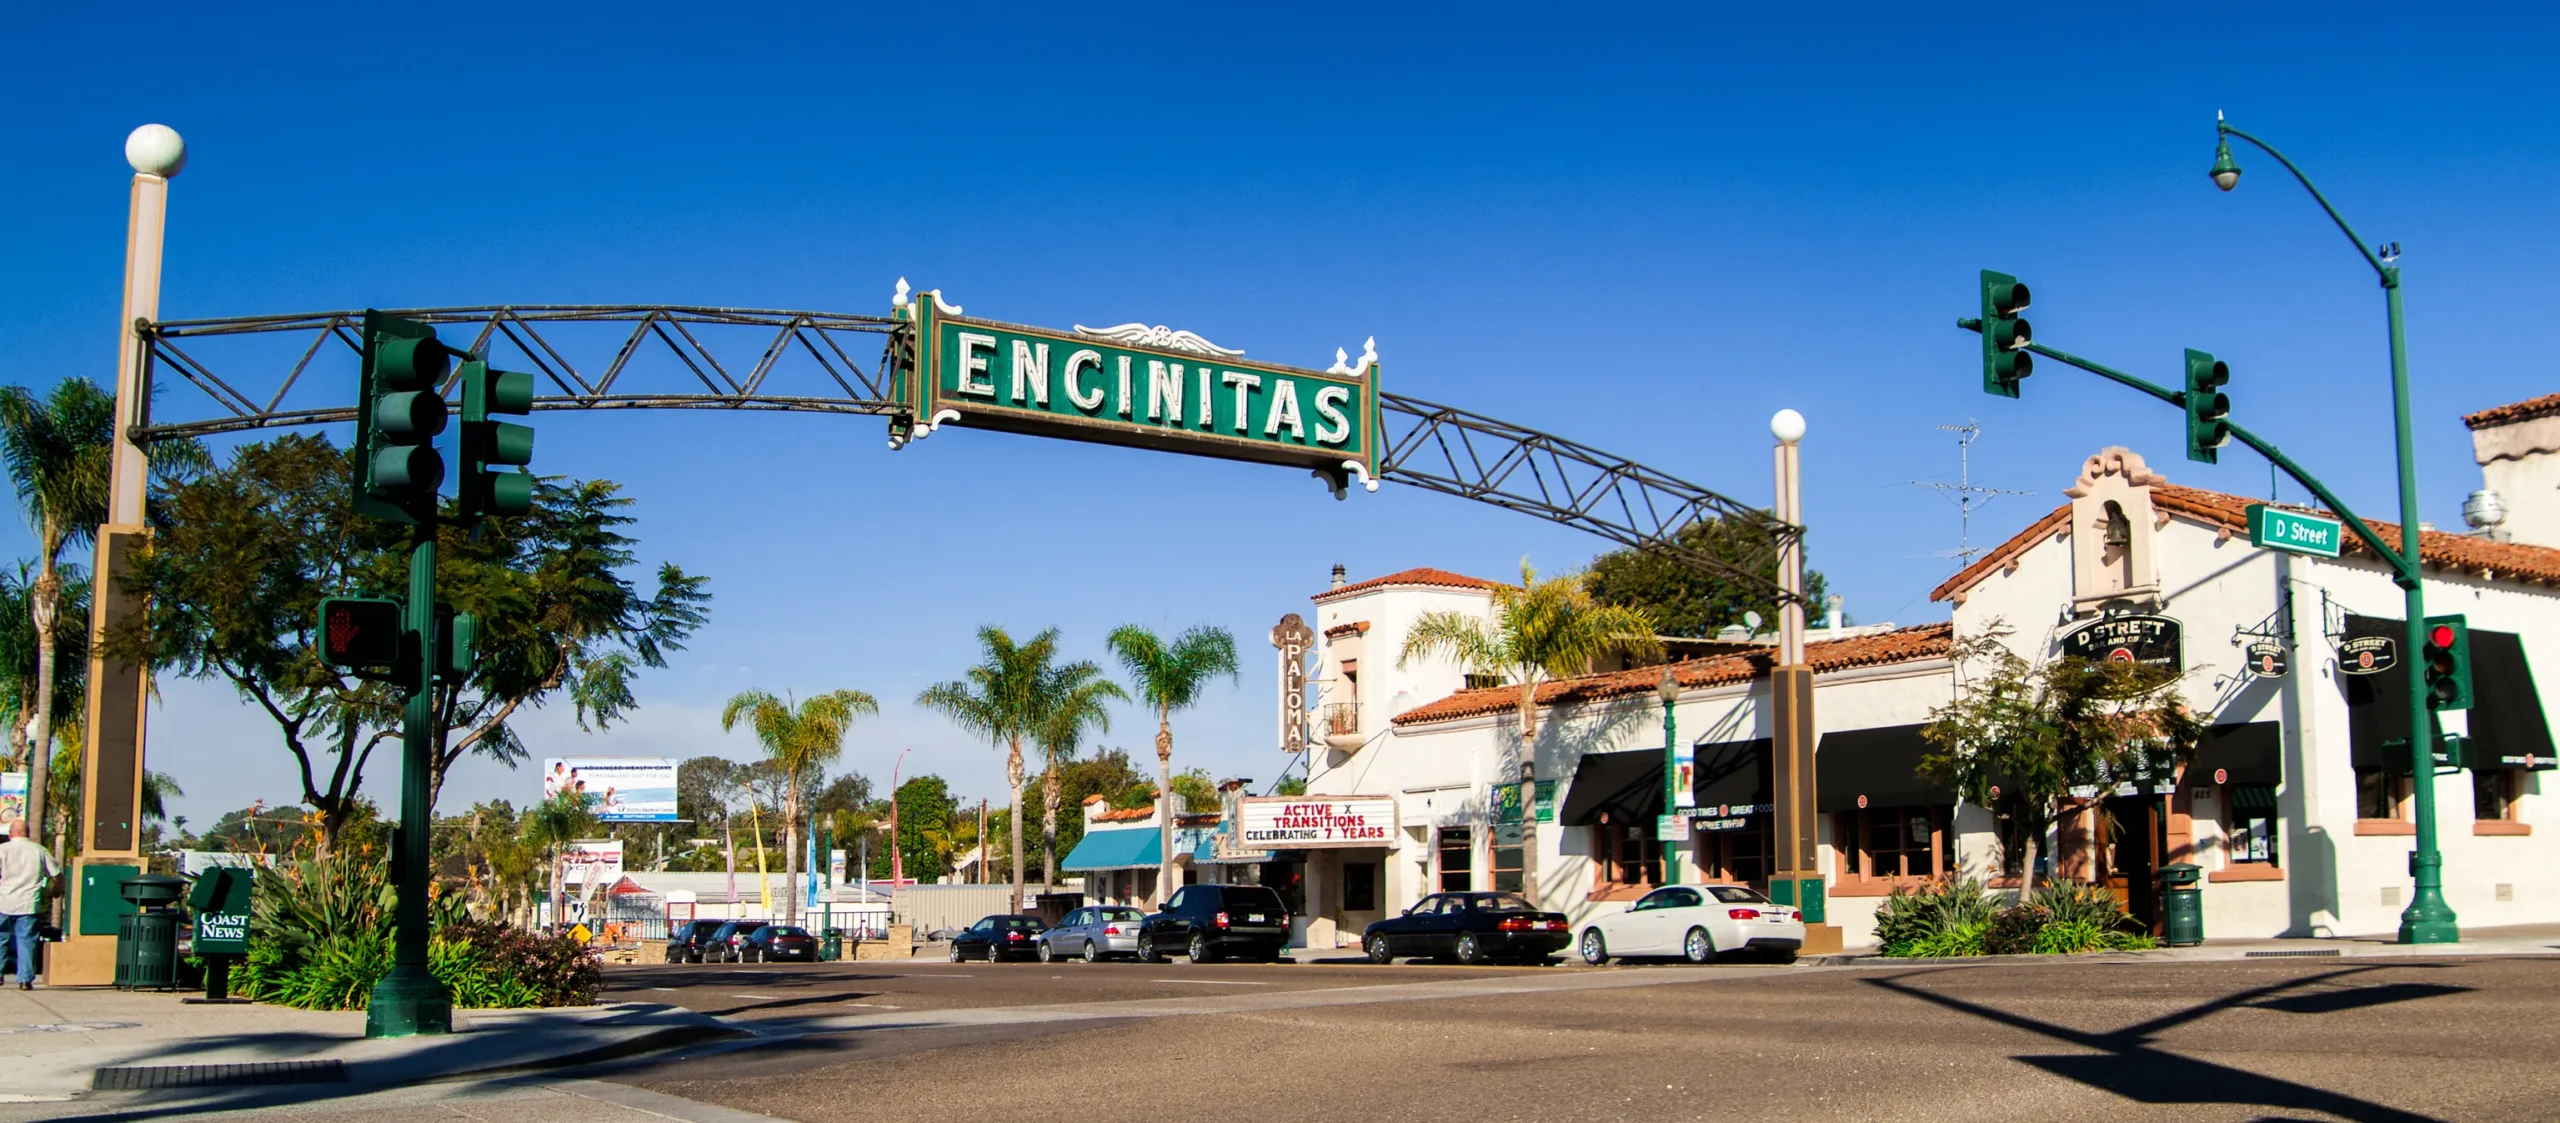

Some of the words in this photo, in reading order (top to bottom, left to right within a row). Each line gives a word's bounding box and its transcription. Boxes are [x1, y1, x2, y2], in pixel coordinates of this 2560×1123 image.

[957, 332, 1351, 445] ENCINITAS
[2276, 519, 2286, 537] D
[2291, 522, 2328, 546] Street
[1285, 630, 1302, 640] LA
[2077, 631, 2090, 646] D
[2094, 620, 2165, 639] STREET
[2107, 636, 2126, 646] AND
[2345, 644, 2351, 652] D
[2353, 639, 2386, 649] STREET
[1287, 644, 1301, 741] PALOMA
[1284, 804, 1332, 816] ACTIVE
[1344, 804, 1352, 815] X
[1698, 806, 1718, 816] TIMES
[1731, 804, 1753, 815] GREAT
[1273, 815, 1365, 829] TRANSITIONS
[1245, 829, 1317, 841] CELEBRATING
[1324, 827, 1333, 840] 7
[1341, 827, 1384, 839] YEARS
[201, 912, 248, 925] COAST
[201, 924, 244, 938] NEWS
